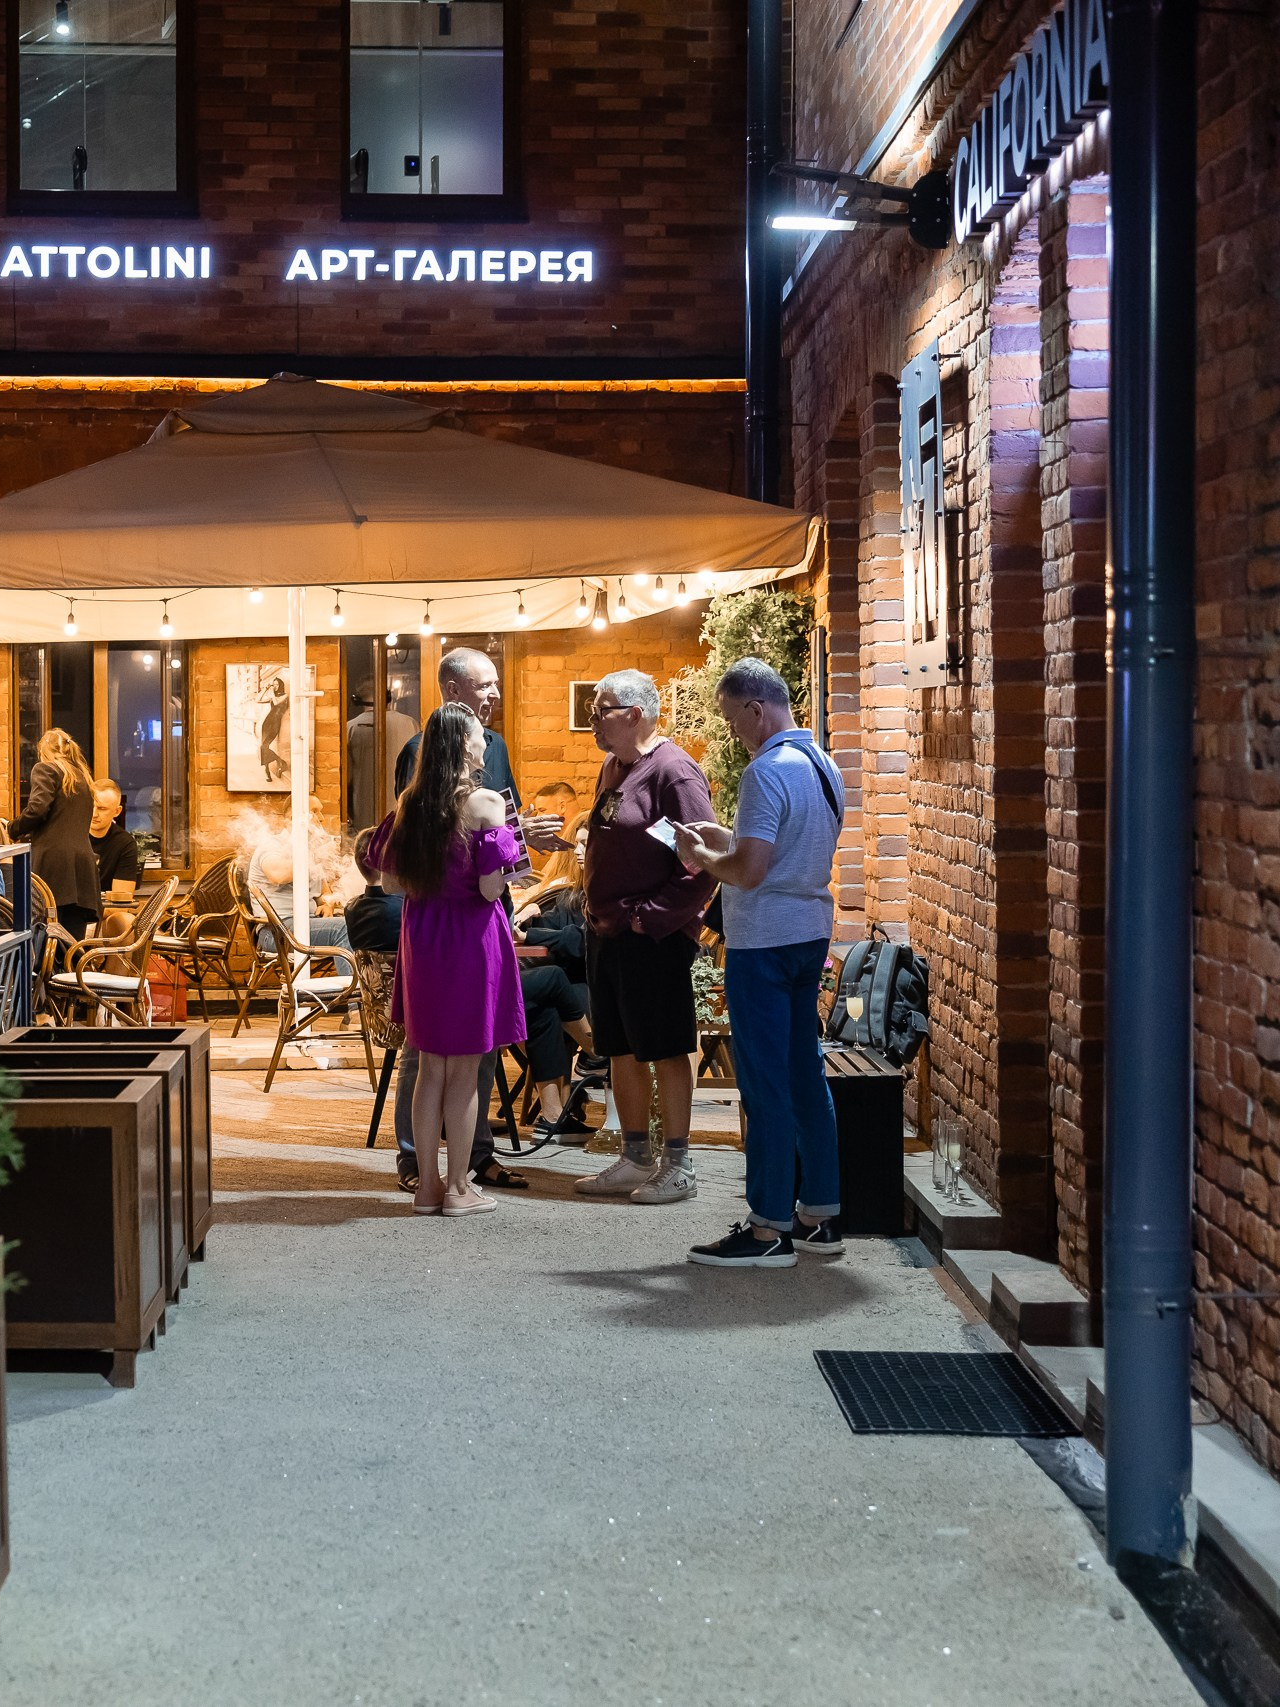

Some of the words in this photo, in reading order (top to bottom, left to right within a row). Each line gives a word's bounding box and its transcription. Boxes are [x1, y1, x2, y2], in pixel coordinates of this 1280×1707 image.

[954, 0, 1110, 244] CALIFORNIA
[0, 245, 211, 279] ATTOLINI
[285, 248, 594, 282] АРТ-ГАЛЕРЕЯ
